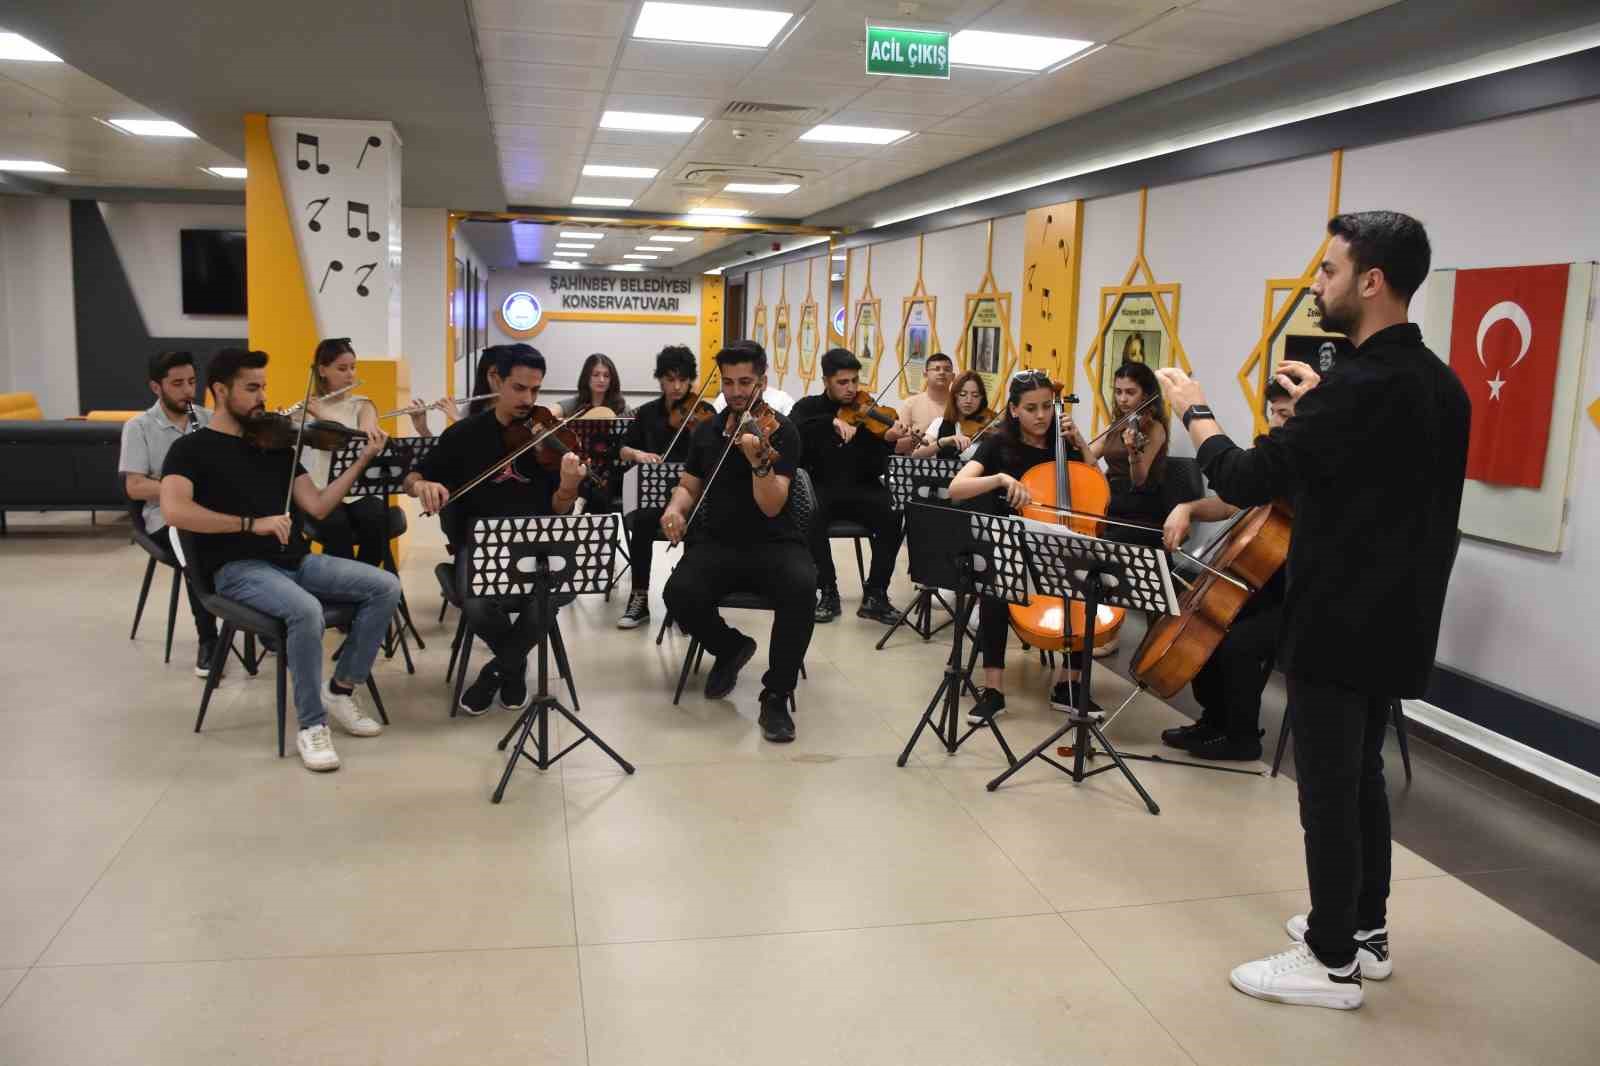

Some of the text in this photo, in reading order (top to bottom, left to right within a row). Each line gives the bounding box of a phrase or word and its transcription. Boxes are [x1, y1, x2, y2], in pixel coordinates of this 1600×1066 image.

[871, 36, 947, 70] ACİL ÇIKIŞ
[550, 275, 692, 294] ŞAHİNBEY BELEDİYESİ
[562, 295, 679, 311] KONSERVATUVARI
